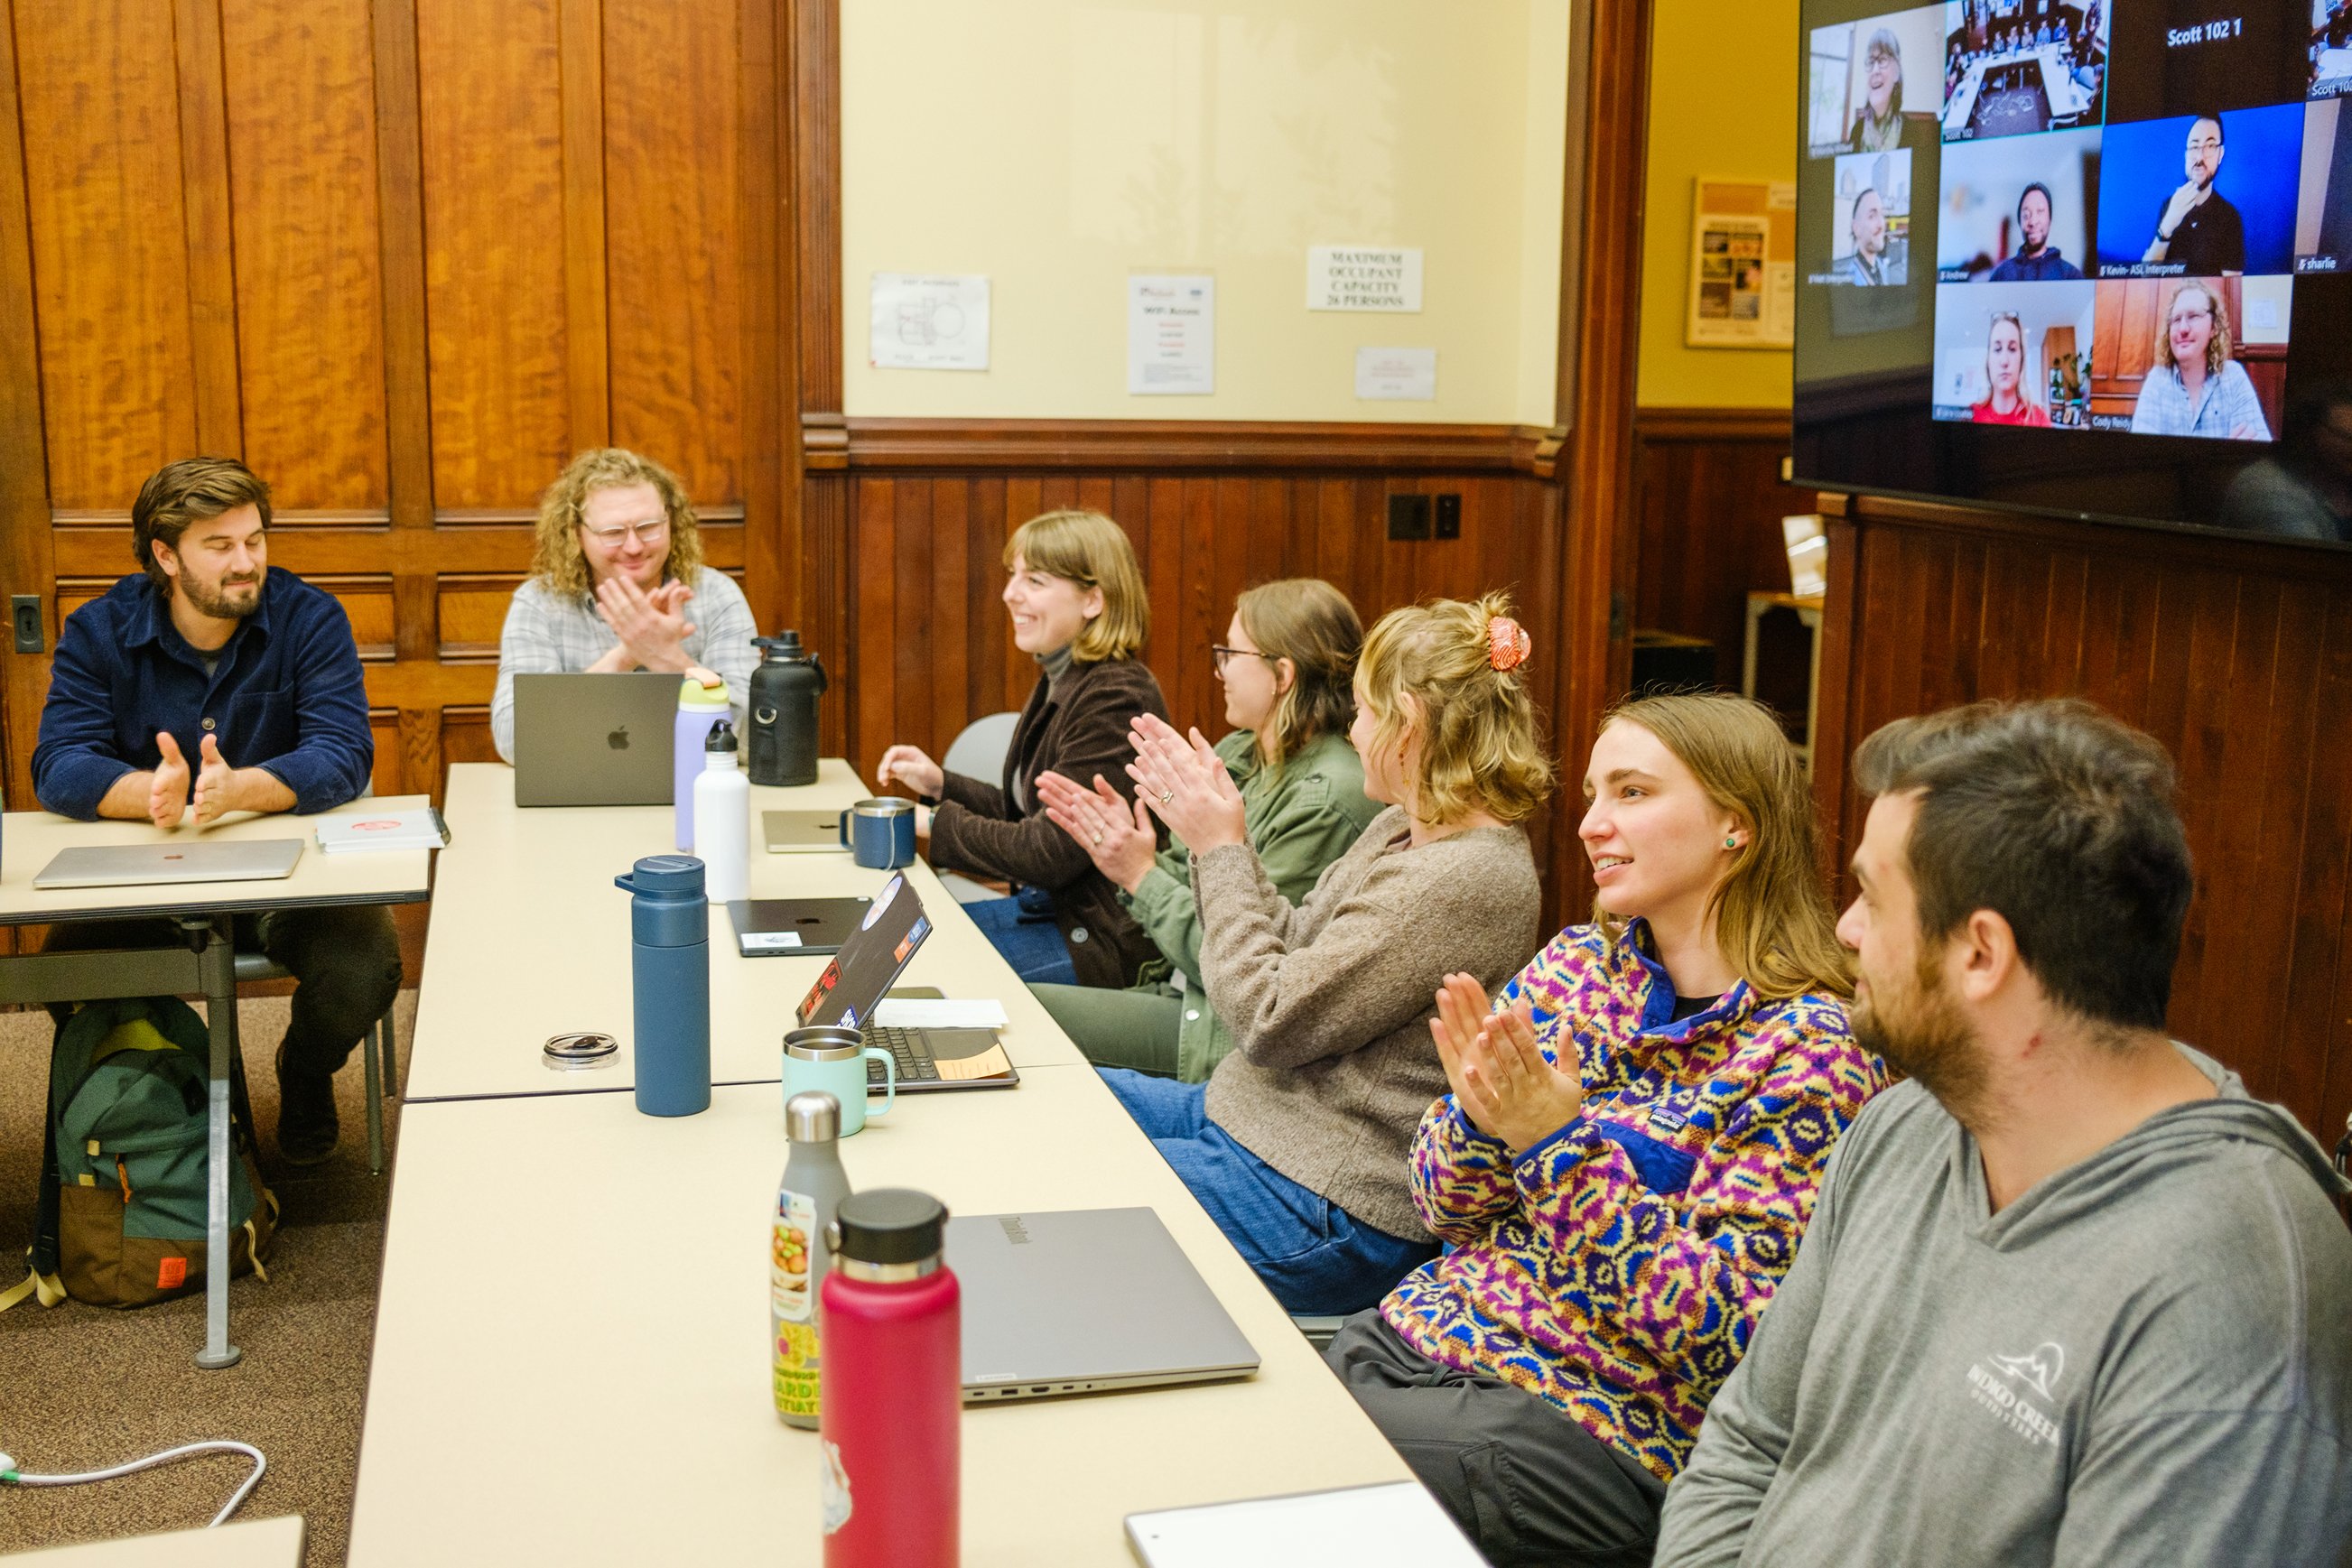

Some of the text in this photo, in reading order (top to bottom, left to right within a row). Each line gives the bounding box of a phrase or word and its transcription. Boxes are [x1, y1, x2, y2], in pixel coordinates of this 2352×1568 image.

[2167, 17, 2242, 47] Scott 102 1
[2311, 80, 2352, 97] Scott 10
[1329, 251, 1402, 264] MAXIMUM
[1328, 266, 1402, 279] OCCUPANT
[1330, 281, 1399, 293] CAPACITY
[1343, 294, 1404, 307] PERSONS
